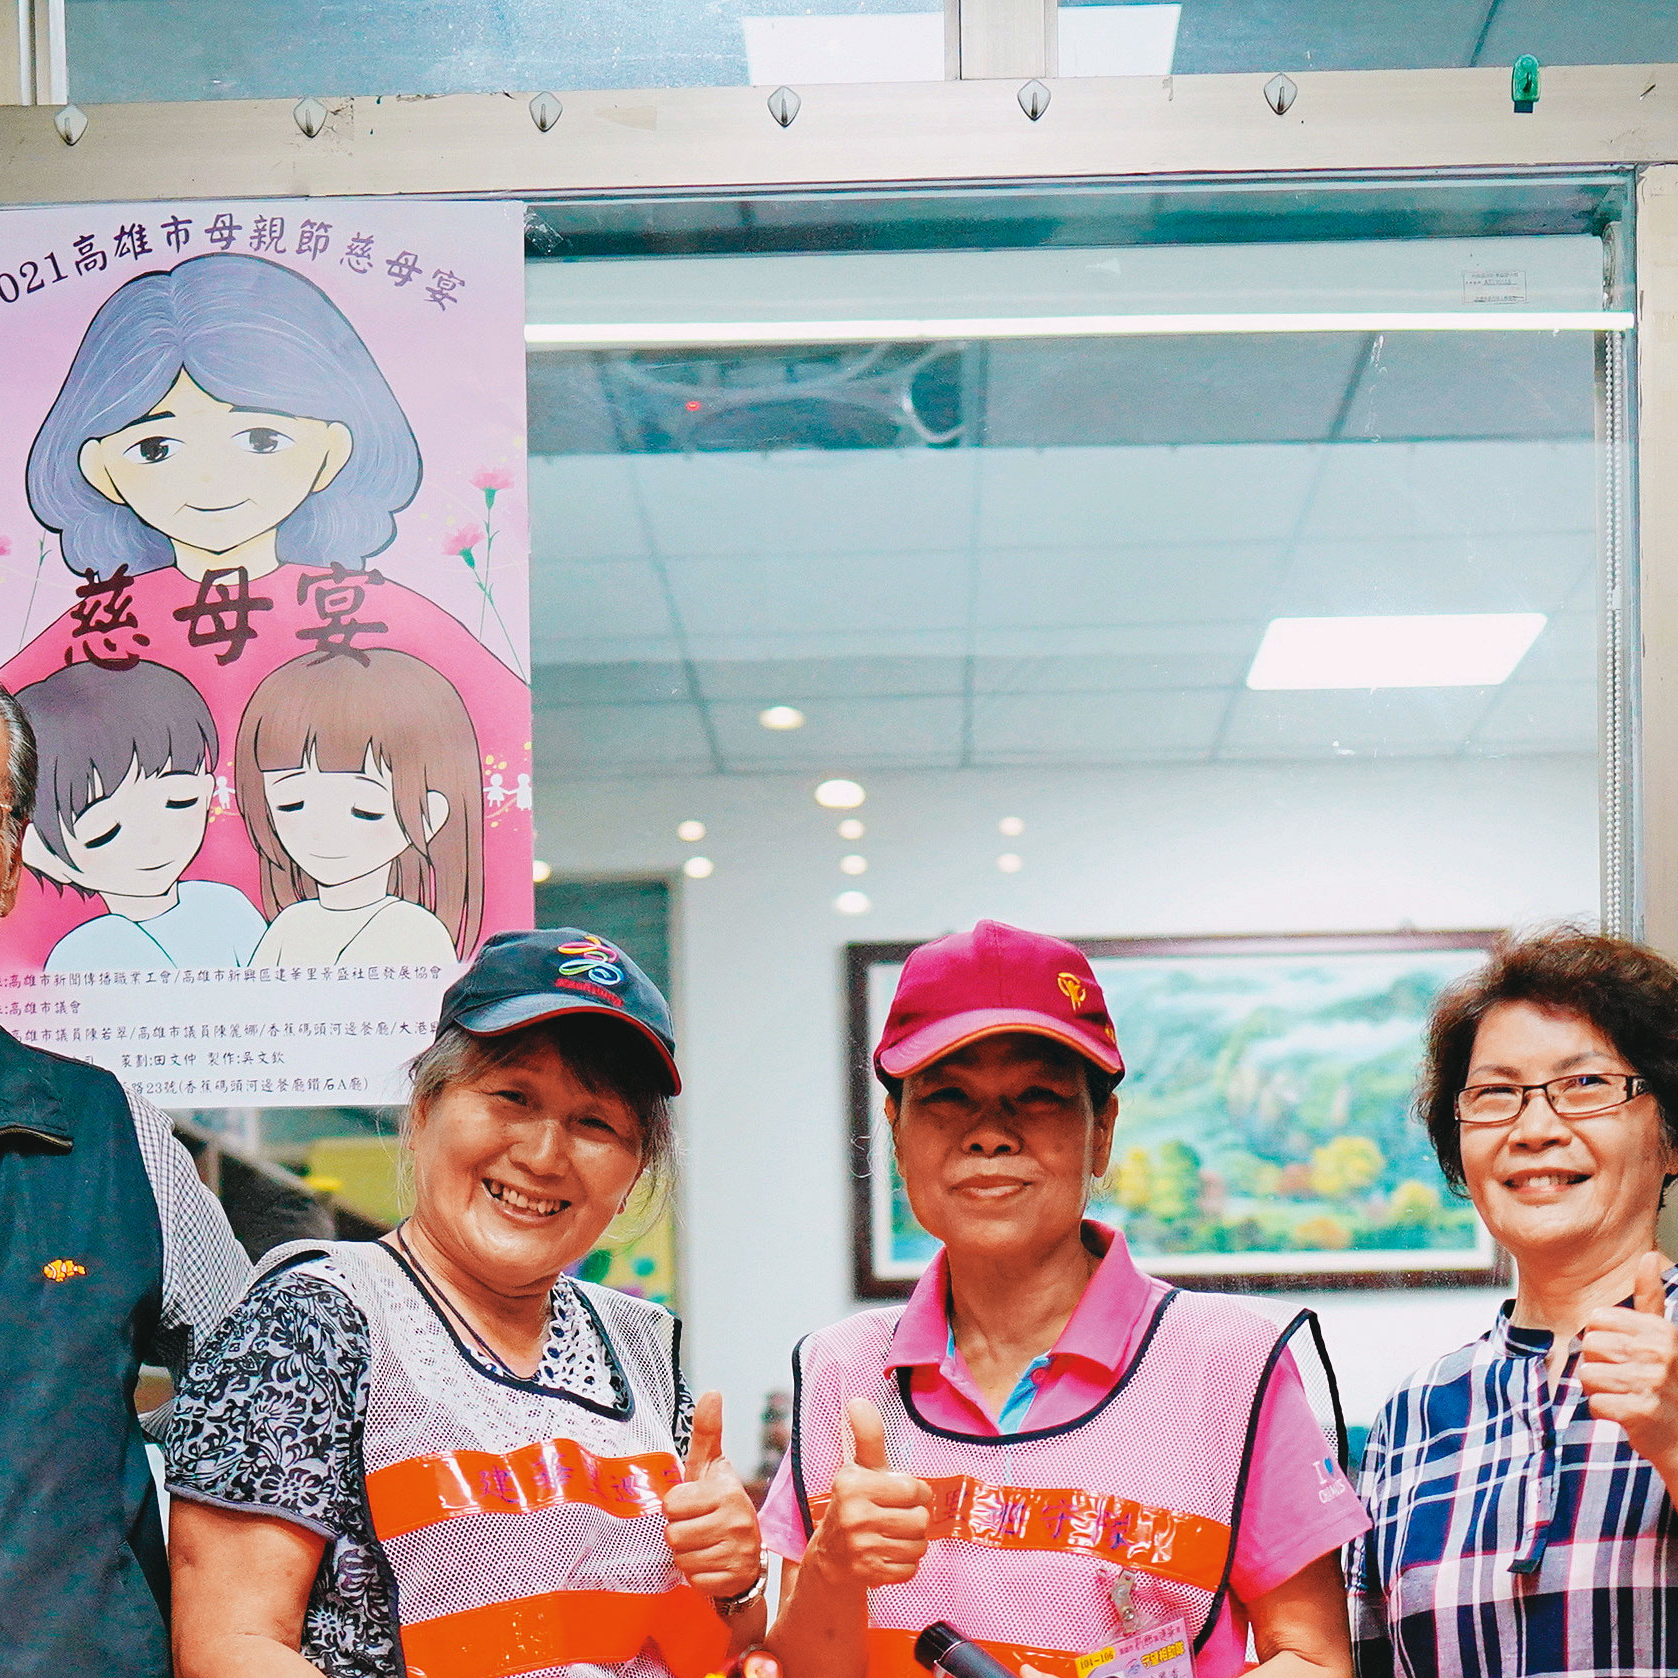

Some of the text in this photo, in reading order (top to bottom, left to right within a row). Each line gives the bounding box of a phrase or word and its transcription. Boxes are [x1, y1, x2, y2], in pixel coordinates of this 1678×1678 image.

[63, 562, 389, 669] 慈母宴
[124, 1076, 370, 1096] 路23號(香蕉碼頭河邊餐廳鑽石A廳)
[1312, 1461, 1328, 1485] I
